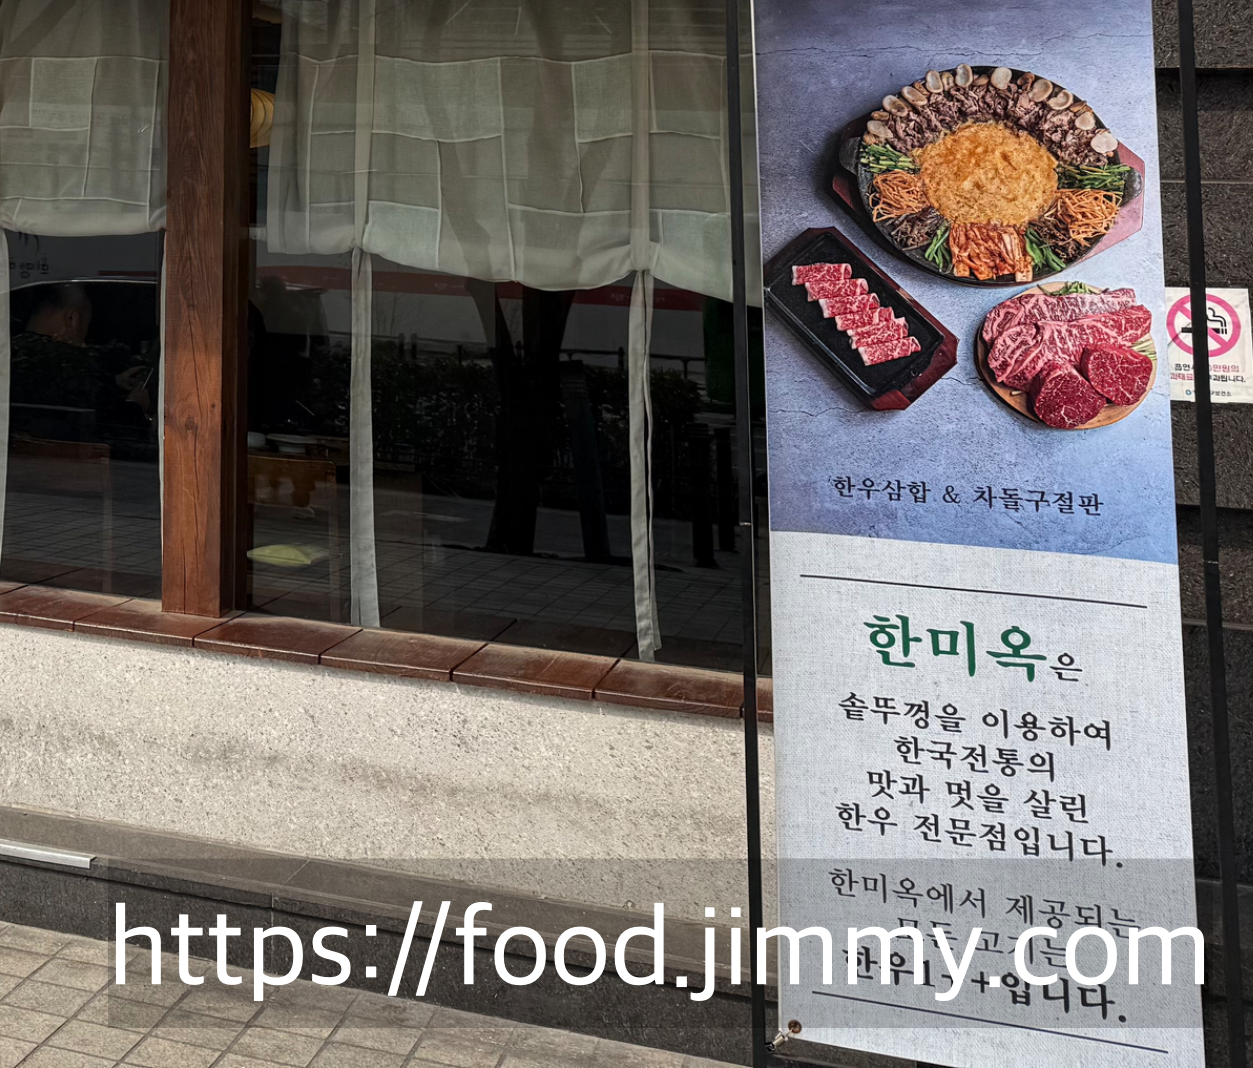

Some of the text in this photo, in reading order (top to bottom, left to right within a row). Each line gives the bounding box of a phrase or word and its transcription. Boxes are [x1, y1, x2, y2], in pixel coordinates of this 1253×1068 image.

[832, 475, 1103, 516] 한우삼합 & 차돌구절판
[982, 708, 1112, 751] 이용하여
[894, 736, 1055, 782] 한국전통의
[866, 769, 1089, 824] 맛과 멋을 살린
[835, 802, 1124, 868] 한우 전문점입니다.
[829, 867, 1141, 939] 한미옥에서 제공되는
